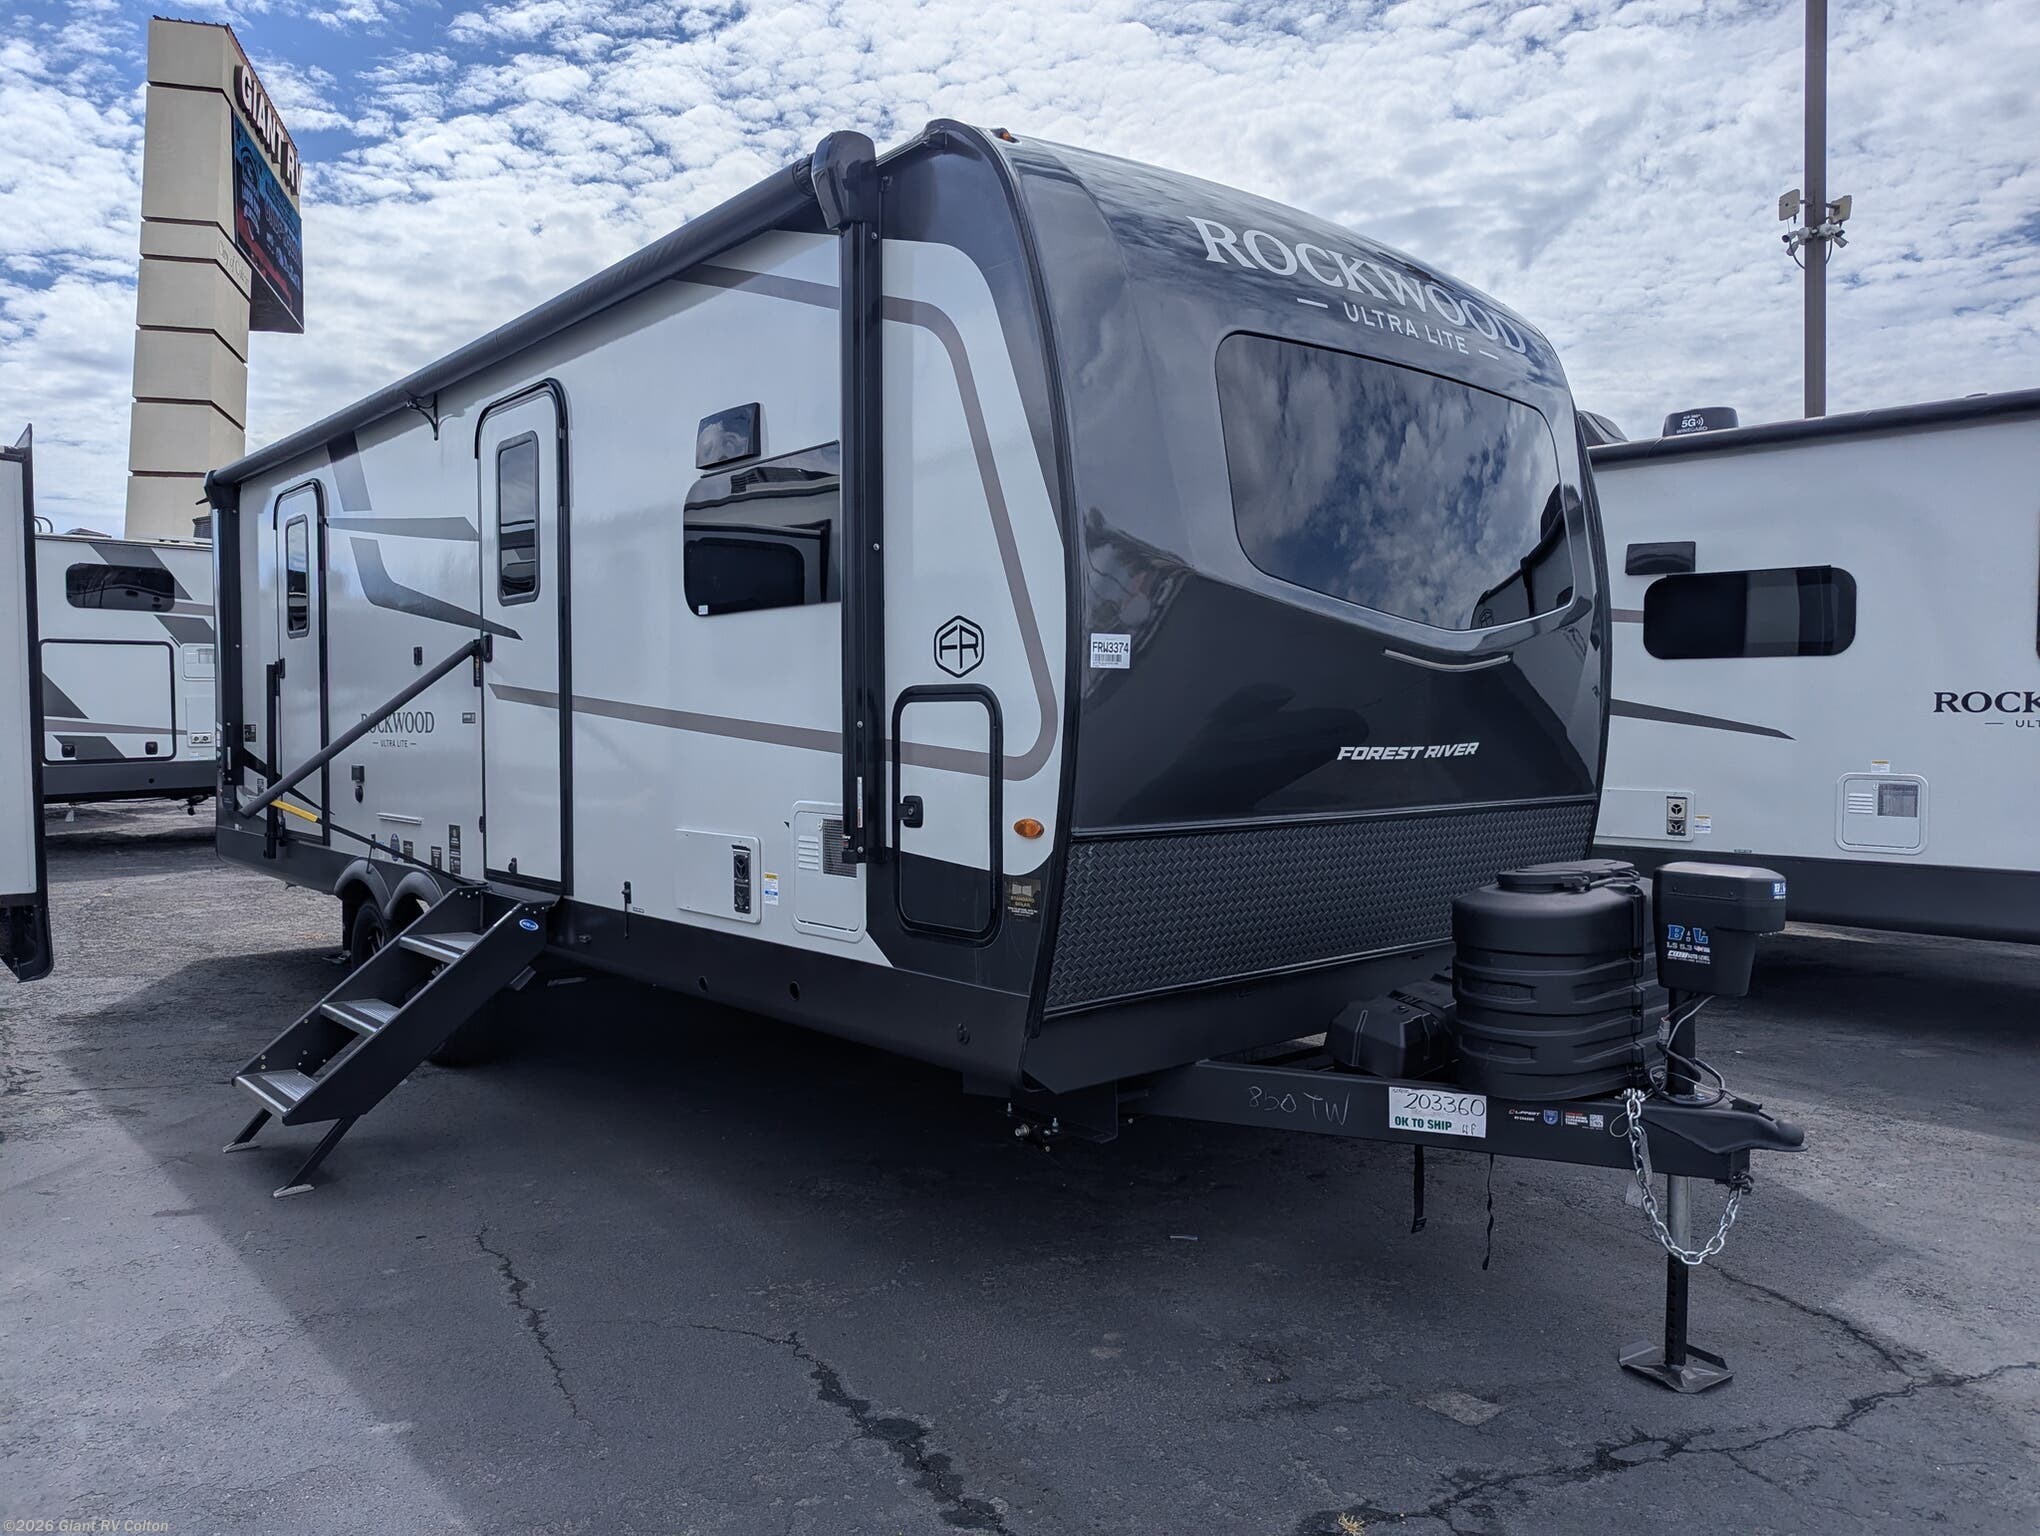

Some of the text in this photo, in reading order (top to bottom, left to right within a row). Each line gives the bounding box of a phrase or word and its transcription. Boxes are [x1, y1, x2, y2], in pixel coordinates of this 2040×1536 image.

[240, 64, 285, 164] GIANT
[286, 143, 303, 196] RV
[1186, 215, 1526, 354] ROCKWOOD
[1343, 301, 1470, 355] ULTRA LITE
[1681, 418, 1696, 428] 5G
[1092, 641, 1129, 654] FRW3374
[381, 739, 408, 748] ULTRA LITE
[1337, 742, 1480, 760] FOREST RIVER
[1303, 1092, 1350, 1125] TW
[1403, 1092, 1485, 1117] 203360
[1394, 1116, 1452, 1131] OK TO SHIP
